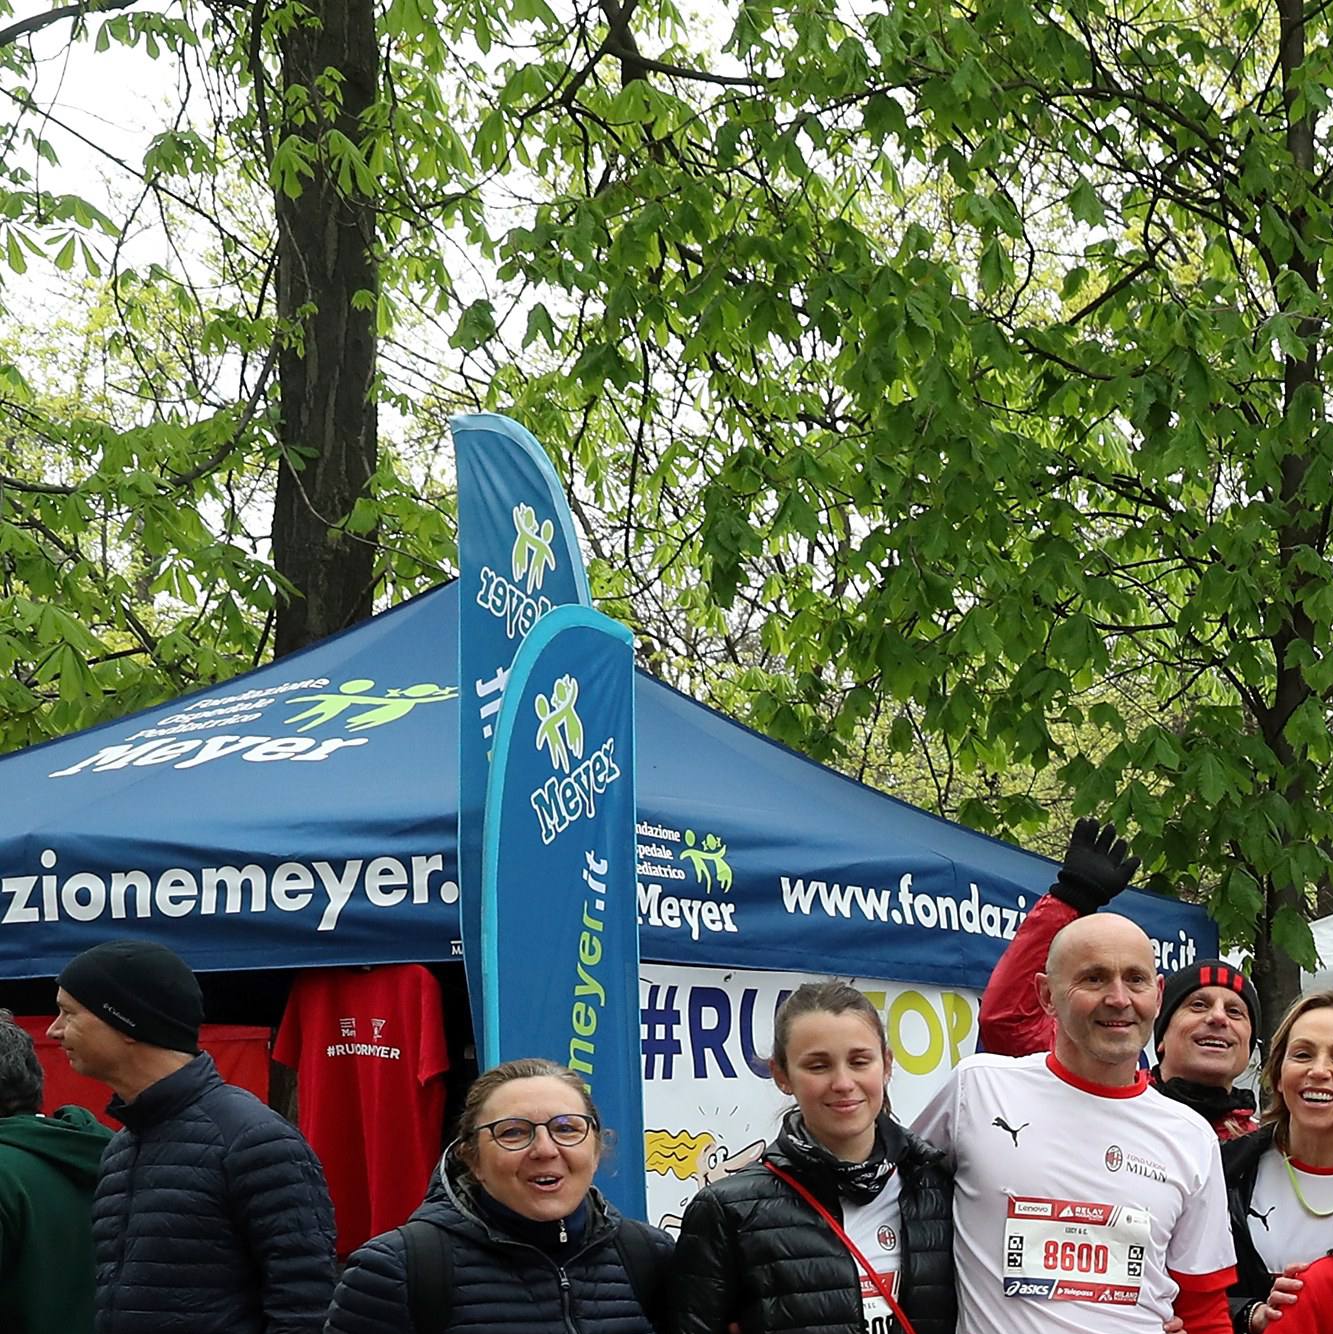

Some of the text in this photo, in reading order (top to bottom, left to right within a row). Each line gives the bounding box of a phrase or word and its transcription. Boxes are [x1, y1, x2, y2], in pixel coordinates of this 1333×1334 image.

[184, 677, 330, 711] Fondazione
[47, 734, 369, 779] Meyer
[530, 737, 621, 845] Meyer
[635, 821, 681, 842] ndazione
[635, 862, 686, 881] ediatrico
[636, 881, 738, 941] Meyer
[1126, 1162, 1168, 1183] MILAN
[1018, 1205, 1048, 1214] Lenovo
[1075, 1207, 1105, 1216] RELAY
[1043, 1240, 1110, 1275] 860D
[1019, 1284, 1049, 1295] asics
[1063, 1287, 1094, 1297] Telepass
[1113, 1290, 1138, 1299] MILANO
